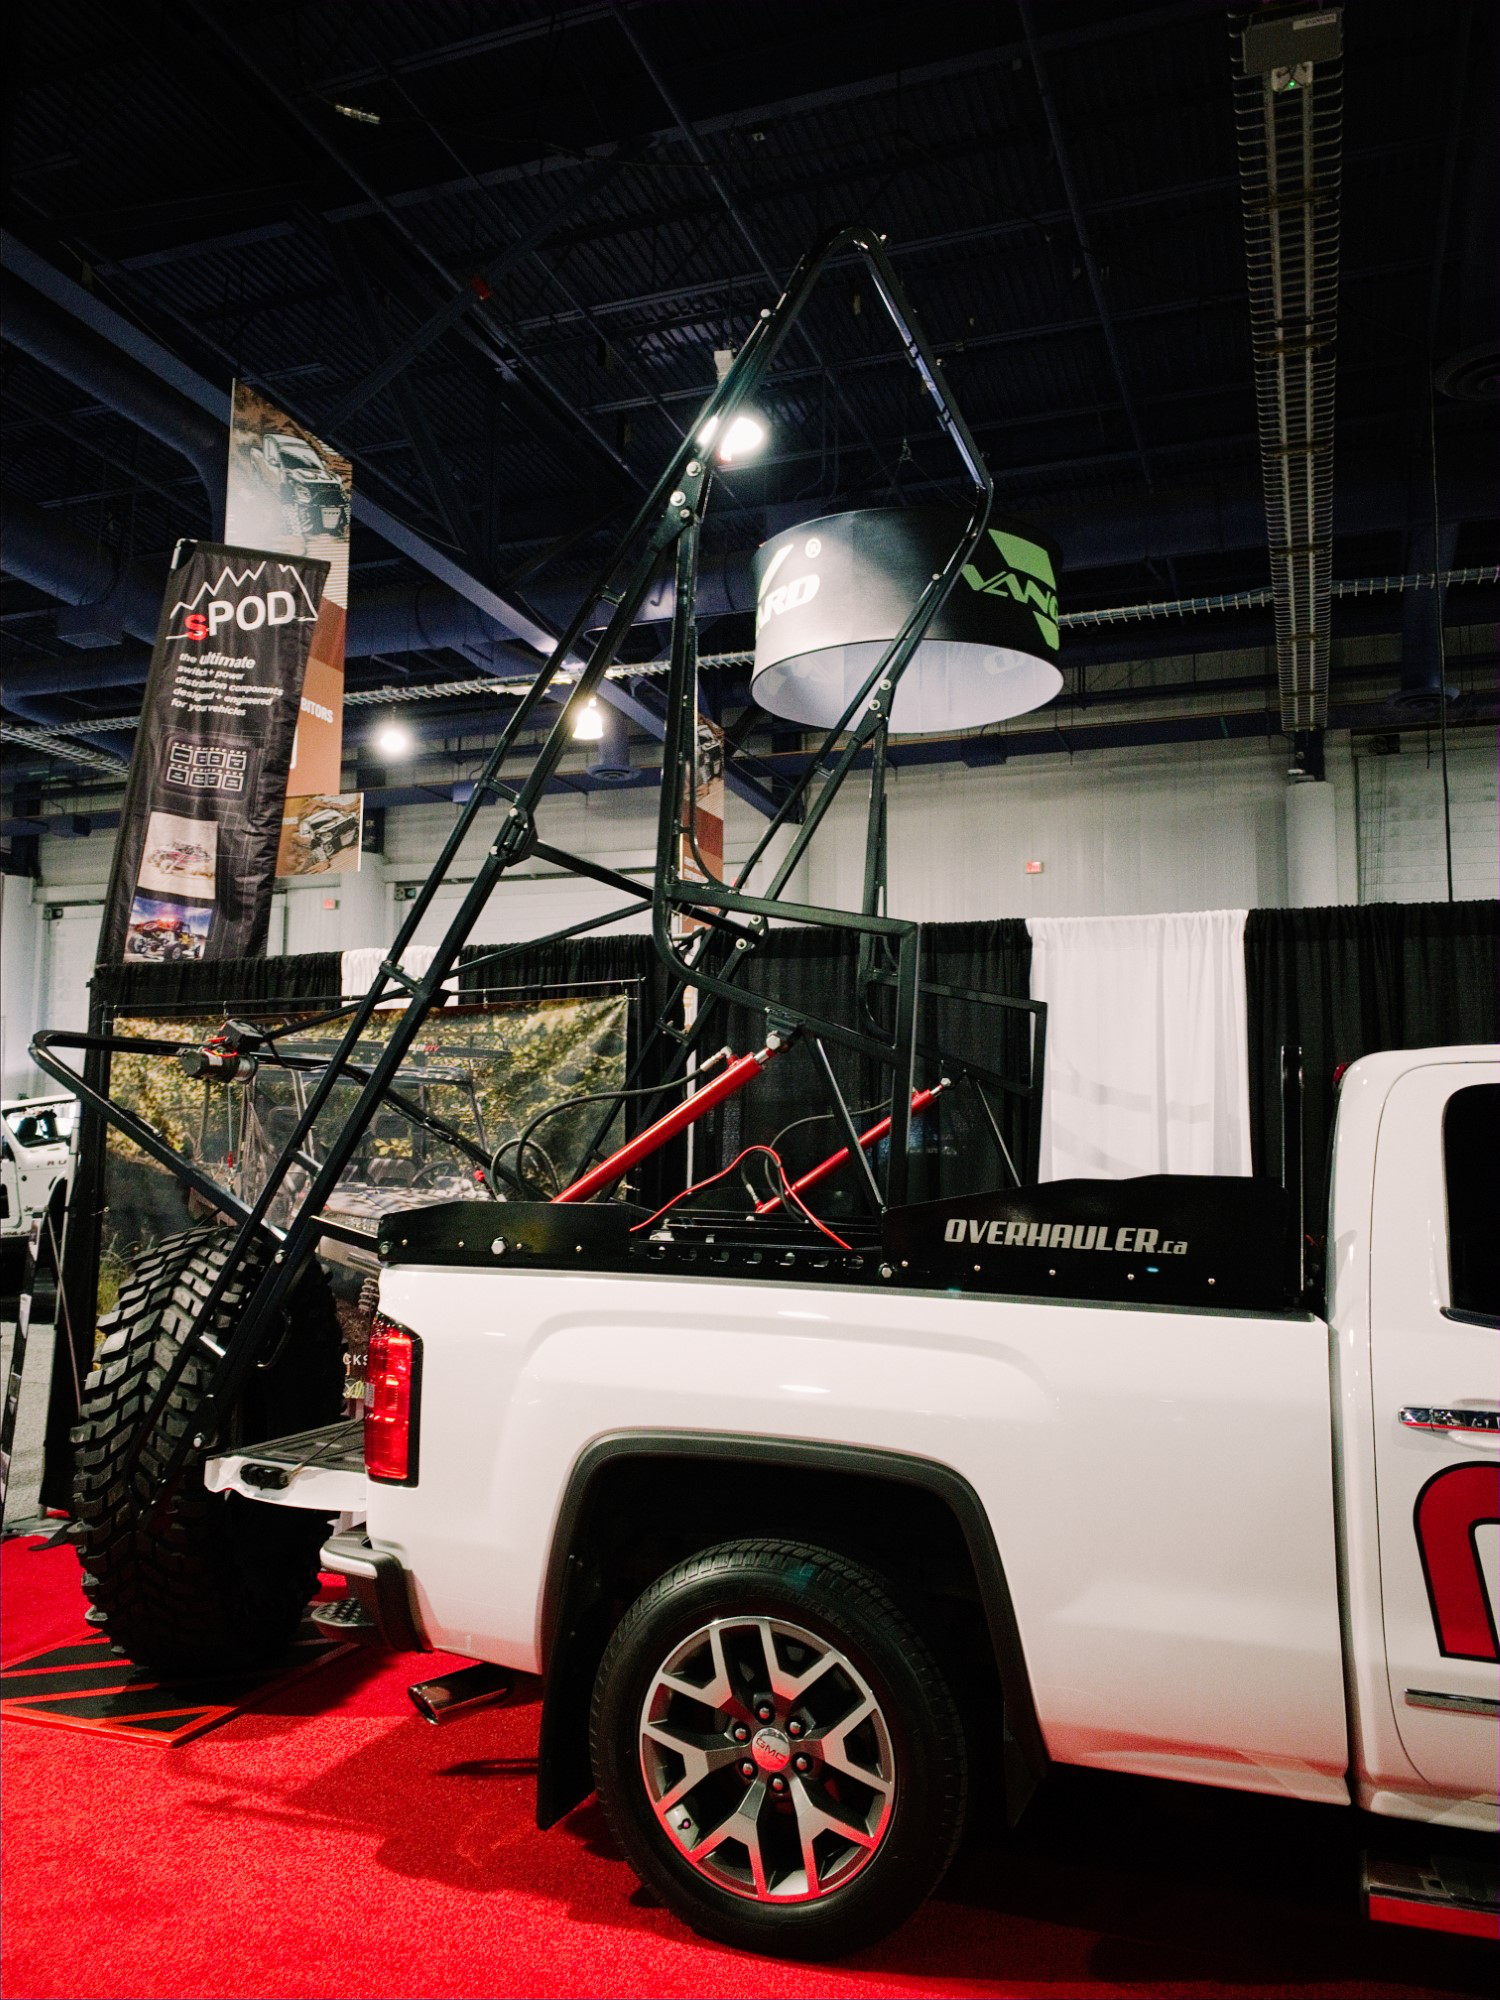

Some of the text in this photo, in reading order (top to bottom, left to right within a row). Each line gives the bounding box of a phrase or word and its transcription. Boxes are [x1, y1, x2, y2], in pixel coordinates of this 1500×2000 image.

[179, 651, 256, 669] the ultimate
[229, 684, 284, 696] components
[171, 698, 187, 707] for
[208, 704, 247, 716] vehicles
[223, 695, 274, 706] engineered
[944, 1218, 1189, 1255] OVERHAULER.ca
[755, 1736, 786, 1763] GMC
